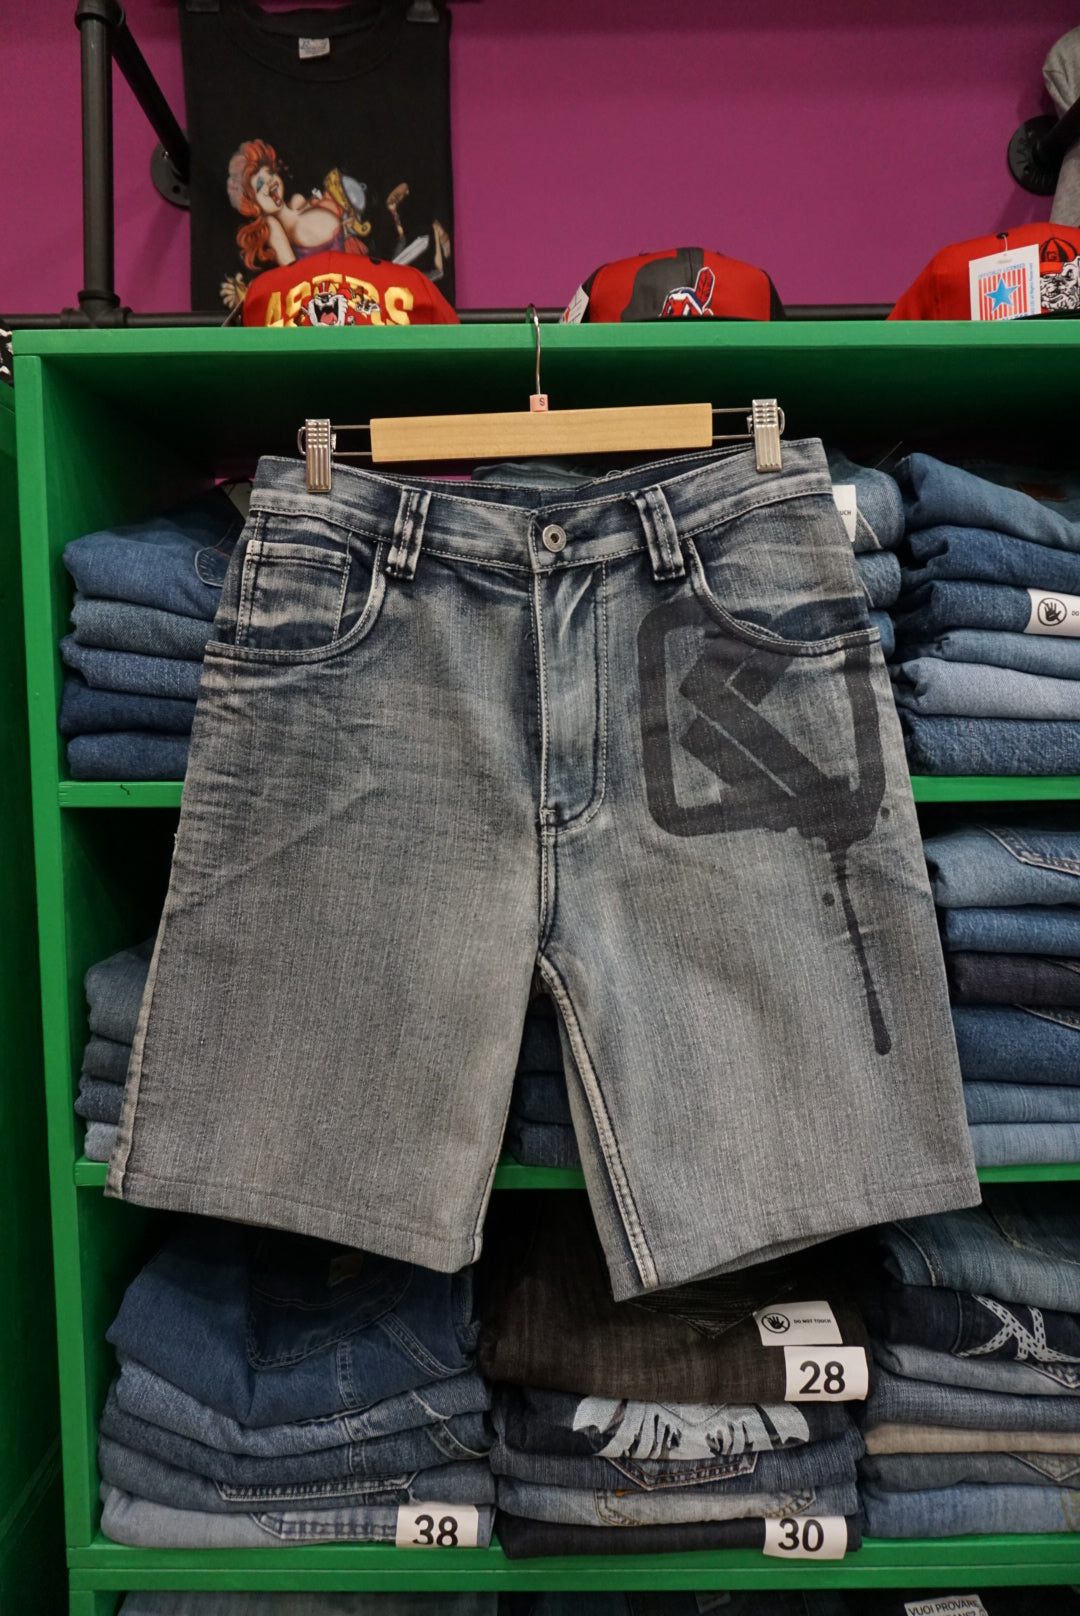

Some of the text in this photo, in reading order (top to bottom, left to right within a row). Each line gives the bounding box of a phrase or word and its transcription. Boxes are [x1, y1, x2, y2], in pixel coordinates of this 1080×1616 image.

[539, 397, 546, 407] S
[799, 1360, 846, 1394] 28
[412, 1514, 458, 1547] 38
[778, 1517, 824, 1552] 30
